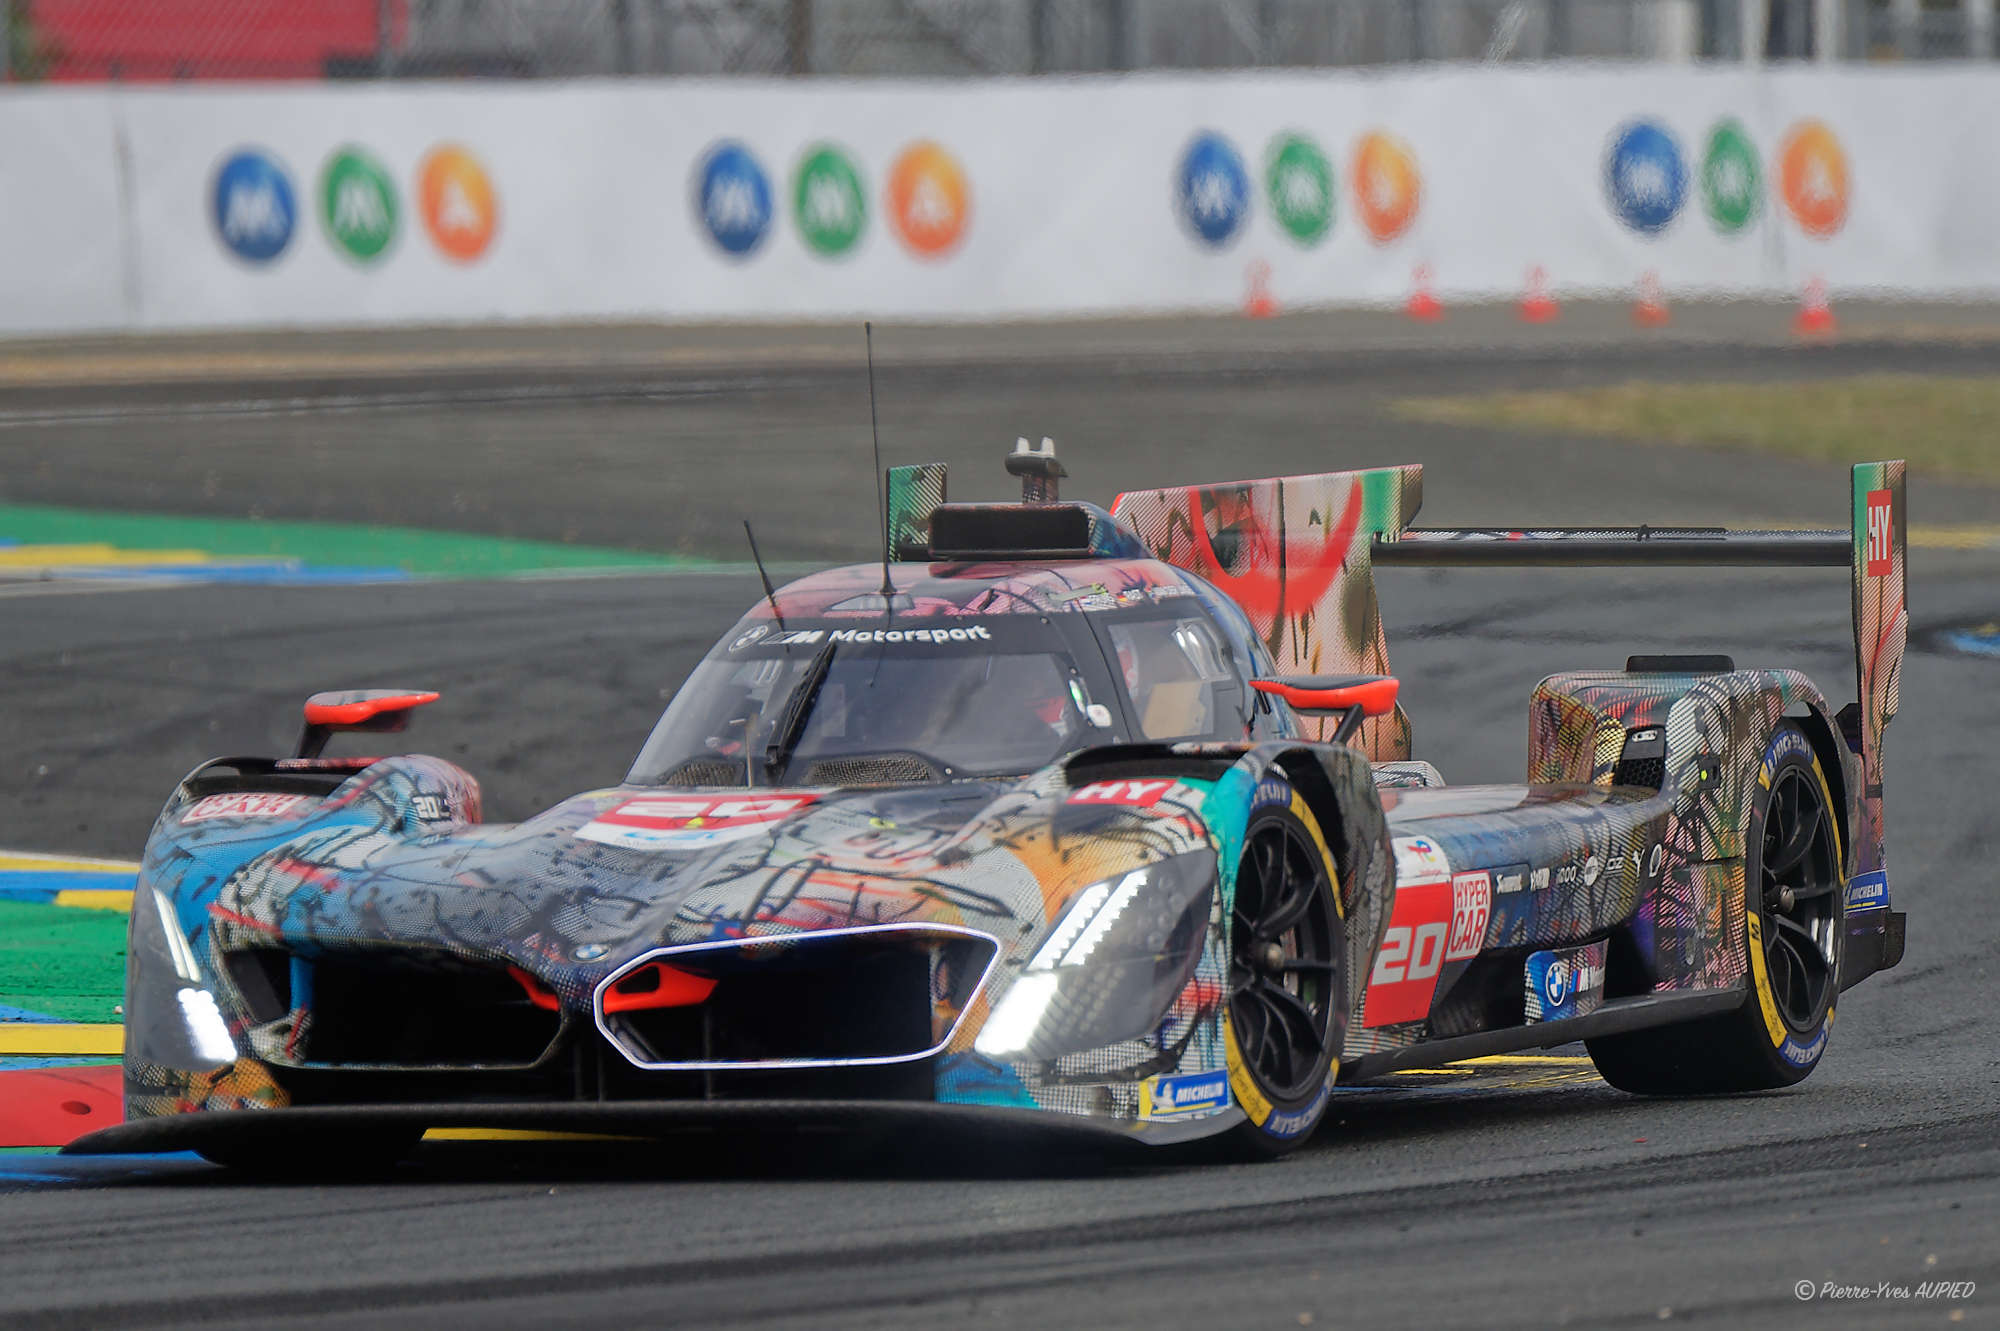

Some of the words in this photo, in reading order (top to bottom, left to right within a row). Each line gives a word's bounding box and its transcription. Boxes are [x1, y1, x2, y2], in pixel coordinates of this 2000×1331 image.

[1868, 504, 1890, 561] HY
[828, 625, 991, 643] Motorsport
[1074, 781, 1168, 800] HY
[1455, 879, 1488, 908] HYPER
[1451, 908, 1486, 953] CAR
[1371, 922, 1449, 986] 20
[1176, 1081, 1225, 1104] MICHELIN
